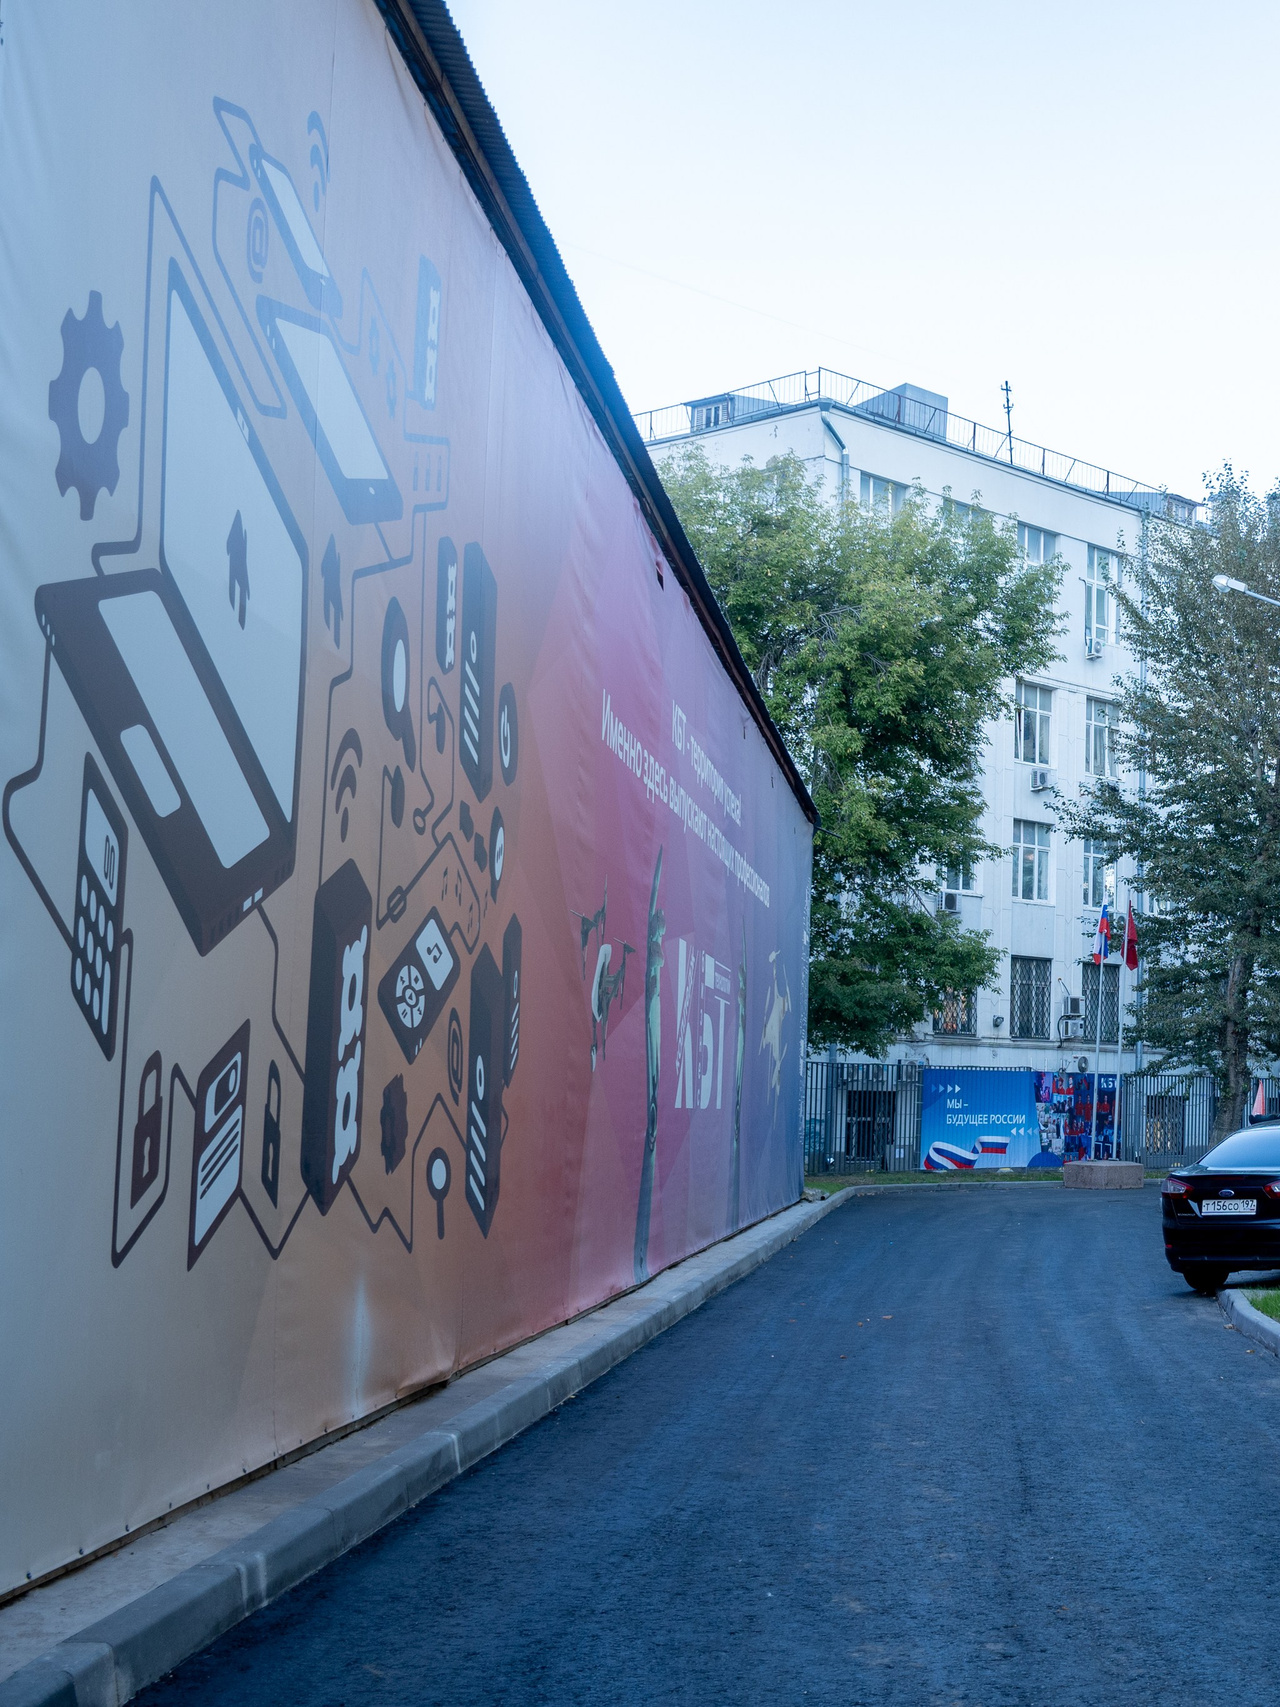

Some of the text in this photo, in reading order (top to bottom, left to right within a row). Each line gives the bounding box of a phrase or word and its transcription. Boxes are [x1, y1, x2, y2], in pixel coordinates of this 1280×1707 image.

[602, 688, 643, 778] Именно
[643, 749, 669, 804] здесь
[669, 775, 708, 843] выпускают
[672, 699, 687, 755] КБТ
[690, 735, 724, 805] территория
[946, 1098, 963, 1109] МЫ
[946, 1114, 1026, 1127] БУДУЩЕЕ РОССИИ
